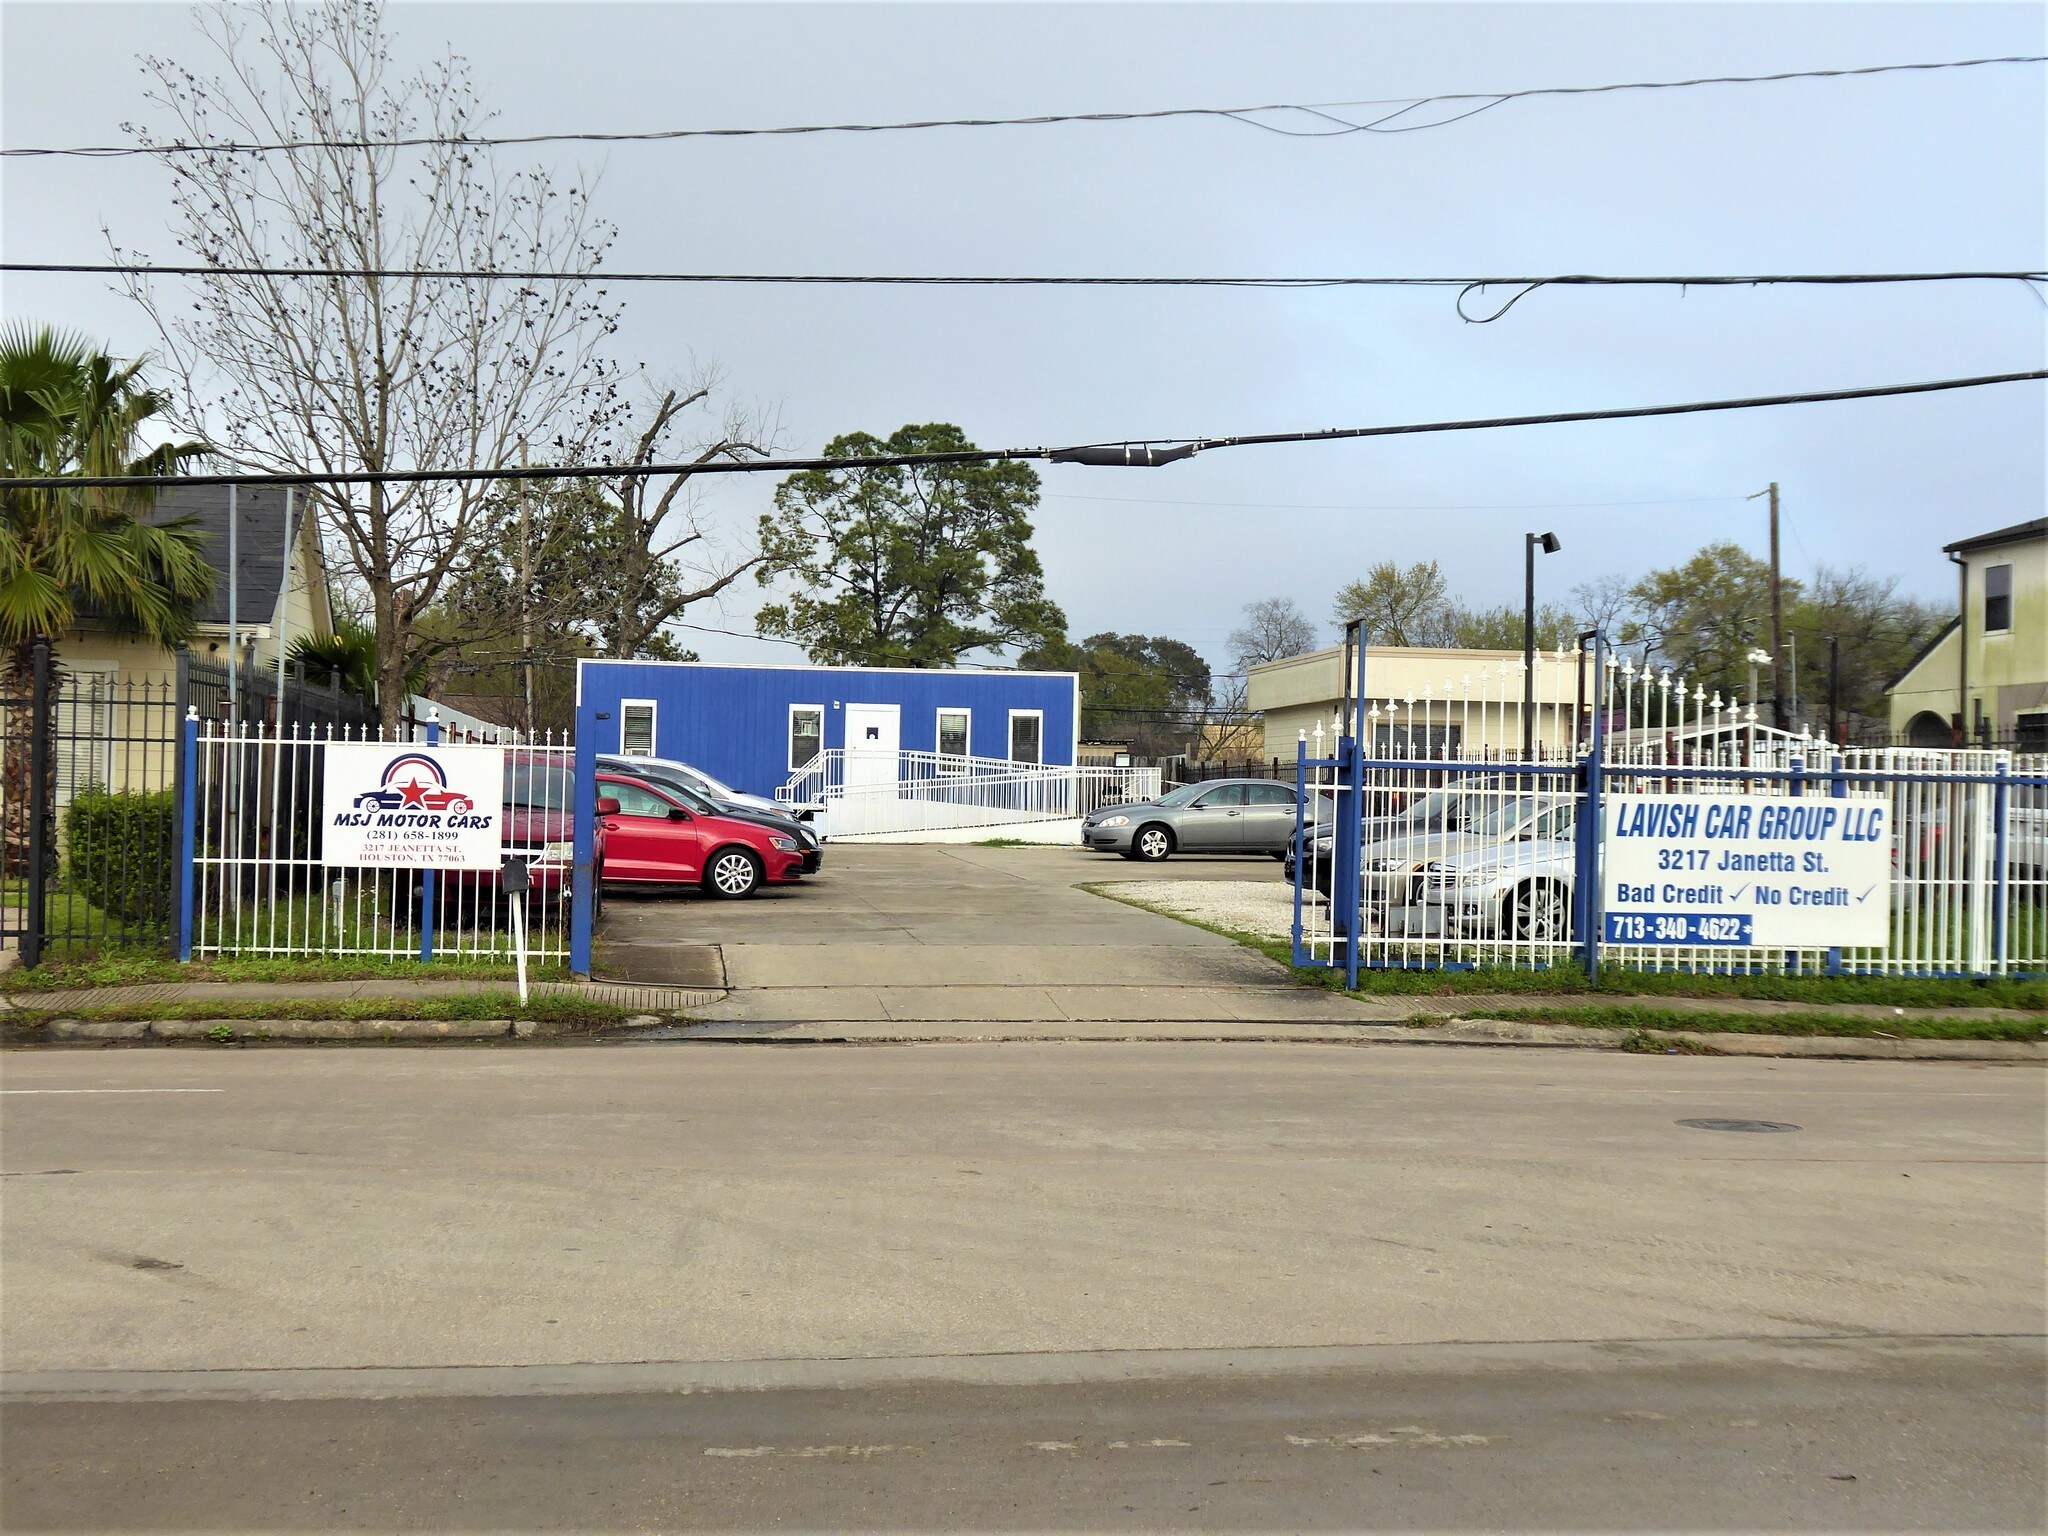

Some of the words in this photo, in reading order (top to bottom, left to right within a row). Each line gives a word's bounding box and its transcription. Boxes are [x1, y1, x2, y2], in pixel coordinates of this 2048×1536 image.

[334, 813, 372, 827] MSJ
[377, 813, 441, 829] MOTOR
[446, 815, 492, 829] CARS
[1616, 803, 1699, 838] LAVISH
[1705, 804, 1752, 839] CAR
[1758, 806, 1837, 841] GROUP
[1842, 808, 1884, 842] LLC
[366, 831, 398, 840] (281)
[403, 831, 459, 840] 658-1899
[363, 844, 384, 852] 3217
[388, 844, 442, 853] JEANETTA
[446, 845, 462, 853] ST.
[359, 853, 417, 862] HOUSTON,
[421, 854, 434, 862] TX
[438, 854, 465, 862] 77063
[1658, 849, 1710, 871] 3217
[1718, 850, 1796, 872] Janetta
[1803, 851, 1829, 873] St.
[1617, 883, 1655, 903] Bad
[1663, 883, 1723, 904] Credit
[1755, 885, 1782, 905] No
[1790, 886, 1849, 906] Credit
